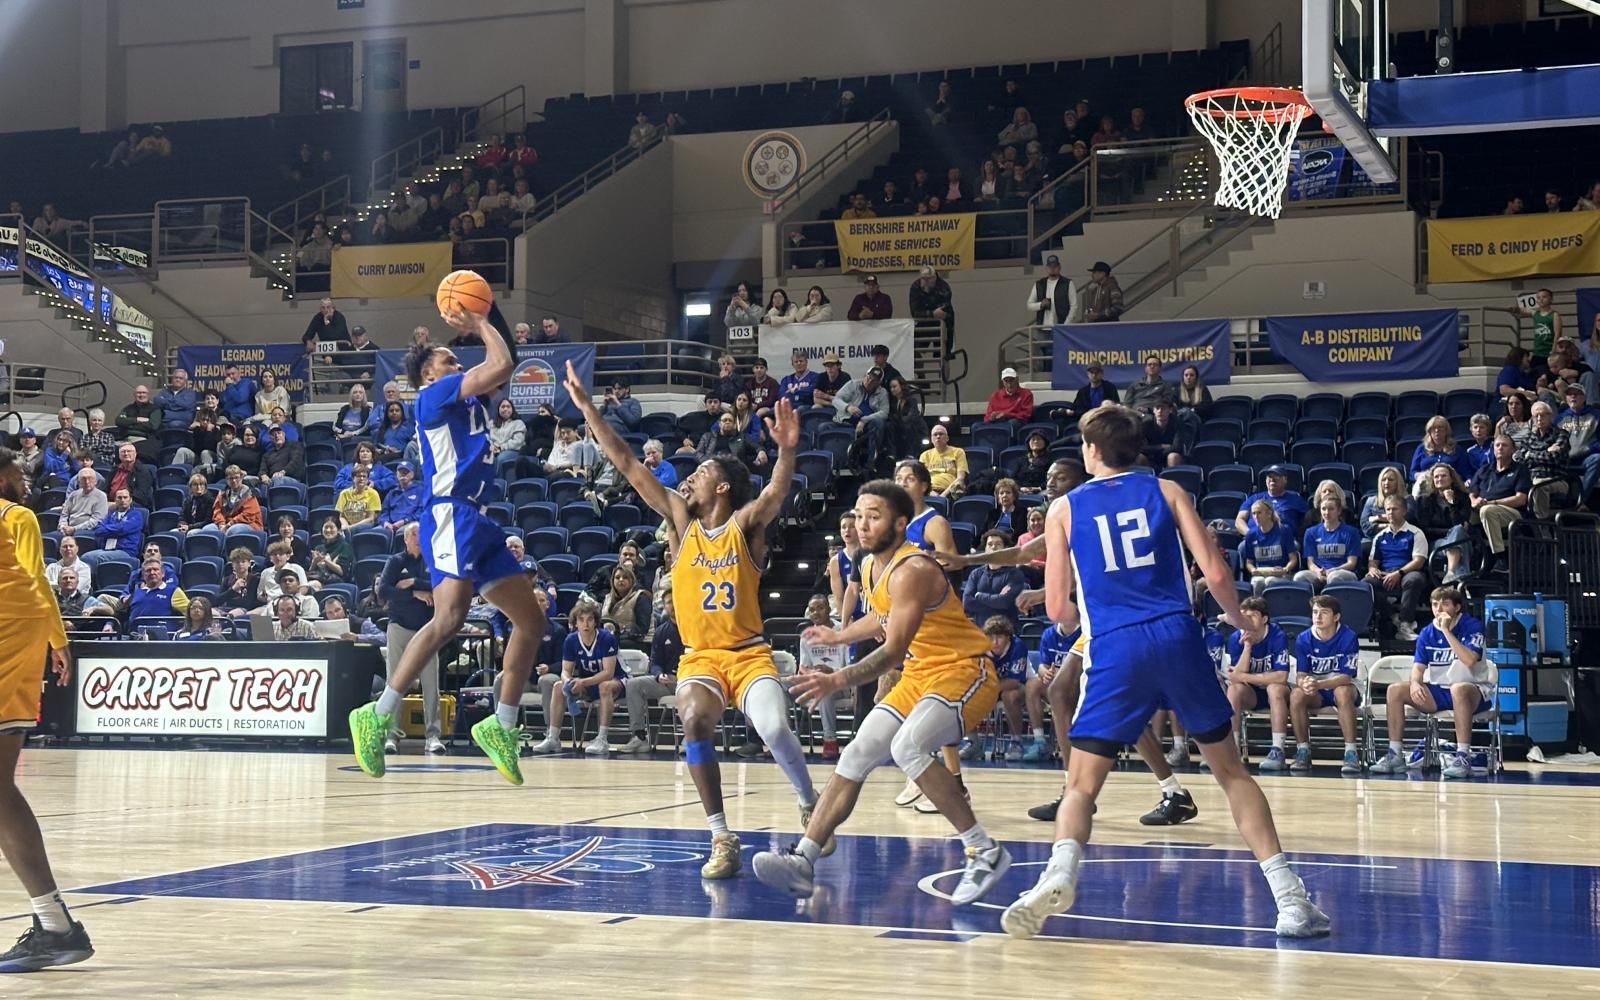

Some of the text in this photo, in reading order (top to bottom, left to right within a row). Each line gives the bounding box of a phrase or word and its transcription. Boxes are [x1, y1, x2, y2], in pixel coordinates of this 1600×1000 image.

[849, 218, 961, 235] BERKSHIRE HATHAWAY
[863, 237, 941, 252] HOME SERVICES
[1451, 233, 1584, 256] FERD & CINDY HOEFS
[908, 254, 961, 266] REALTORS
[358, 262, 425, 276] CURRY DAWSON
[731, 327, 750, 338] 103
[1301, 326, 1422, 345] A-B DISTRIBUTING
[221, 349, 265, 361] LEGRAND
[317, 342, 334, 353] 103
[1068, 345, 1213, 365] PRINCIPAL INDUSTRIES
[1328, 347, 1394, 363] COMPANY
[1092, 507, 1156, 573] 12
[690, 548, 741, 576] Angelo
[701, 581, 736, 613] 23
[82, 666, 323, 713] CARPET TECH
[97, 717, 305, 730] FLOOR CARE AIR DUCTS RESTORATION
